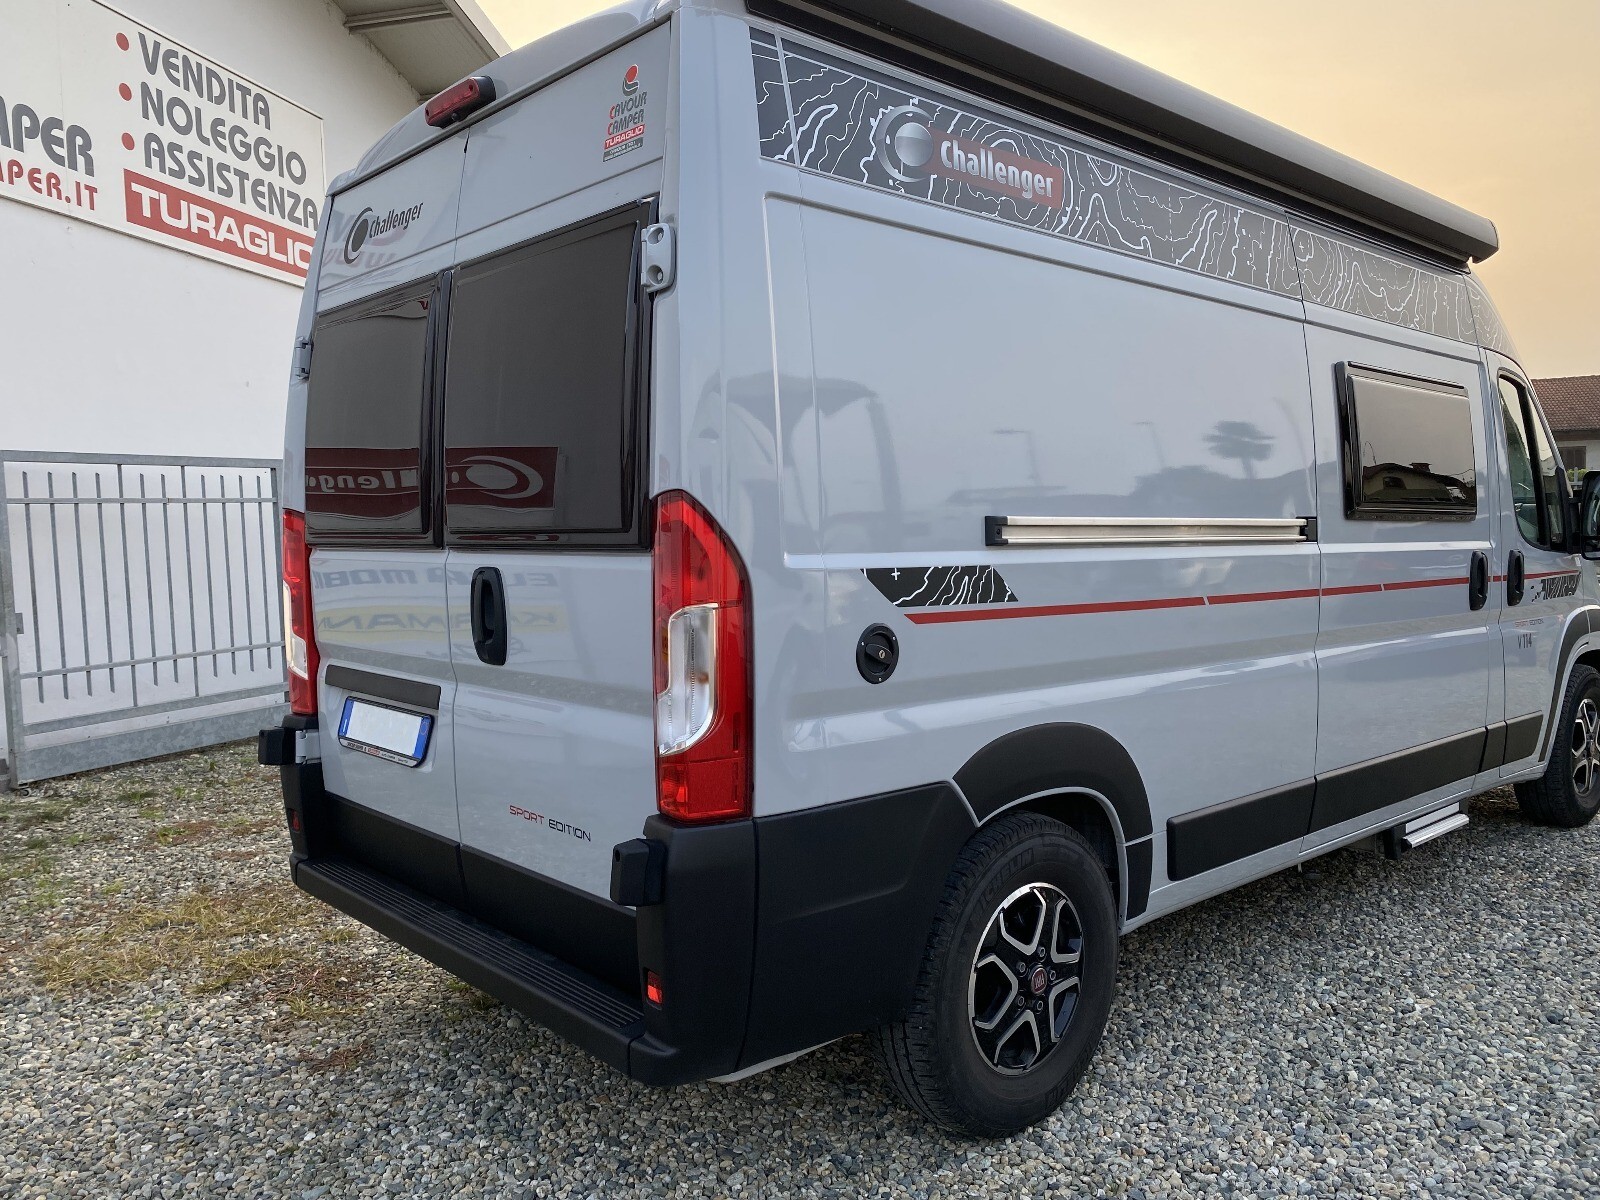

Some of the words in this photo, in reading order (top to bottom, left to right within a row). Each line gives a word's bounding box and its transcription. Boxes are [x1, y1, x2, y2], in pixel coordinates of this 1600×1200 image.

[137, 31, 271, 130] VENDITA
[607, 108, 645, 136] CAMPER
[609, 91, 648, 120] CAVOUR
[140, 81, 307, 185] NOLEGGIO
[605, 125, 644, 148] TURAGLIO
[0, 158, 98, 211] PER.IT
[144, 132, 319, 232] ASSISTENZA
[940, 139, 1054, 199] Challenger
[368, 202, 424, 239] Challenger
[509, 804, 545, 825] SPORT
[548, 818, 591, 842] EDITION
